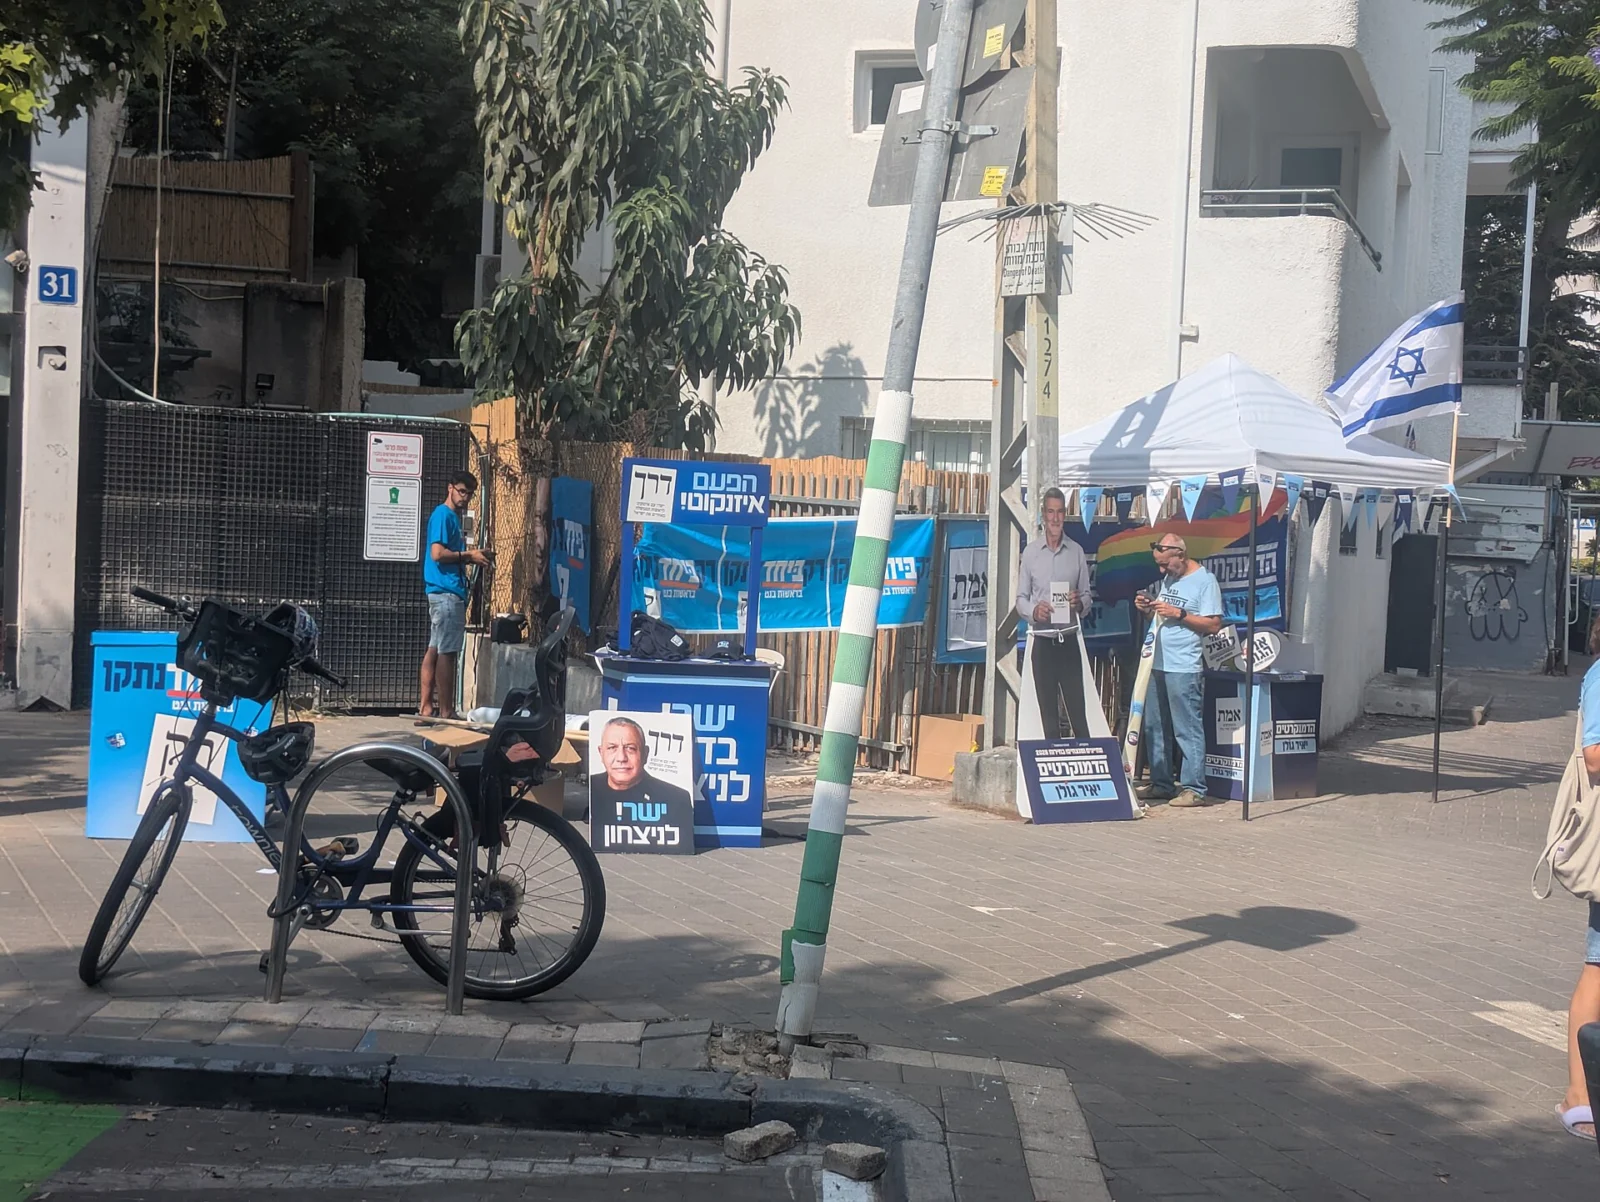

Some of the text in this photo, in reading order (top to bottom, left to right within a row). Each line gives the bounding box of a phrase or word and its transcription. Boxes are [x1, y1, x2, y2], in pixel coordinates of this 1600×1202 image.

[1029, 242, 1045, 252] מתח
[43, 271, 72, 298] 31
[635, 471, 672, 500] דרך
[693, 471, 758, 493] הפעם
[680, 492, 766, 515] איזנקוט!
[763, 560, 805, 582] ביחד
[885, 557, 917, 580] ביח
[952, 571, 988, 600] אמת
[102, 660, 166, 692] נתקן
[1218, 709, 1241, 722] אמת
[1276, 723, 1316, 735] הדמוקרטים
[648, 729, 684, 756] דרך
[1037, 760, 1110, 776] הדמוקרטים
[1055, 784, 1101, 800] יאיר גולן
[616, 802, 667, 821] ישר!
[231, 804, 282, 865] townie
[604, 824, 680, 847] לניצחון
